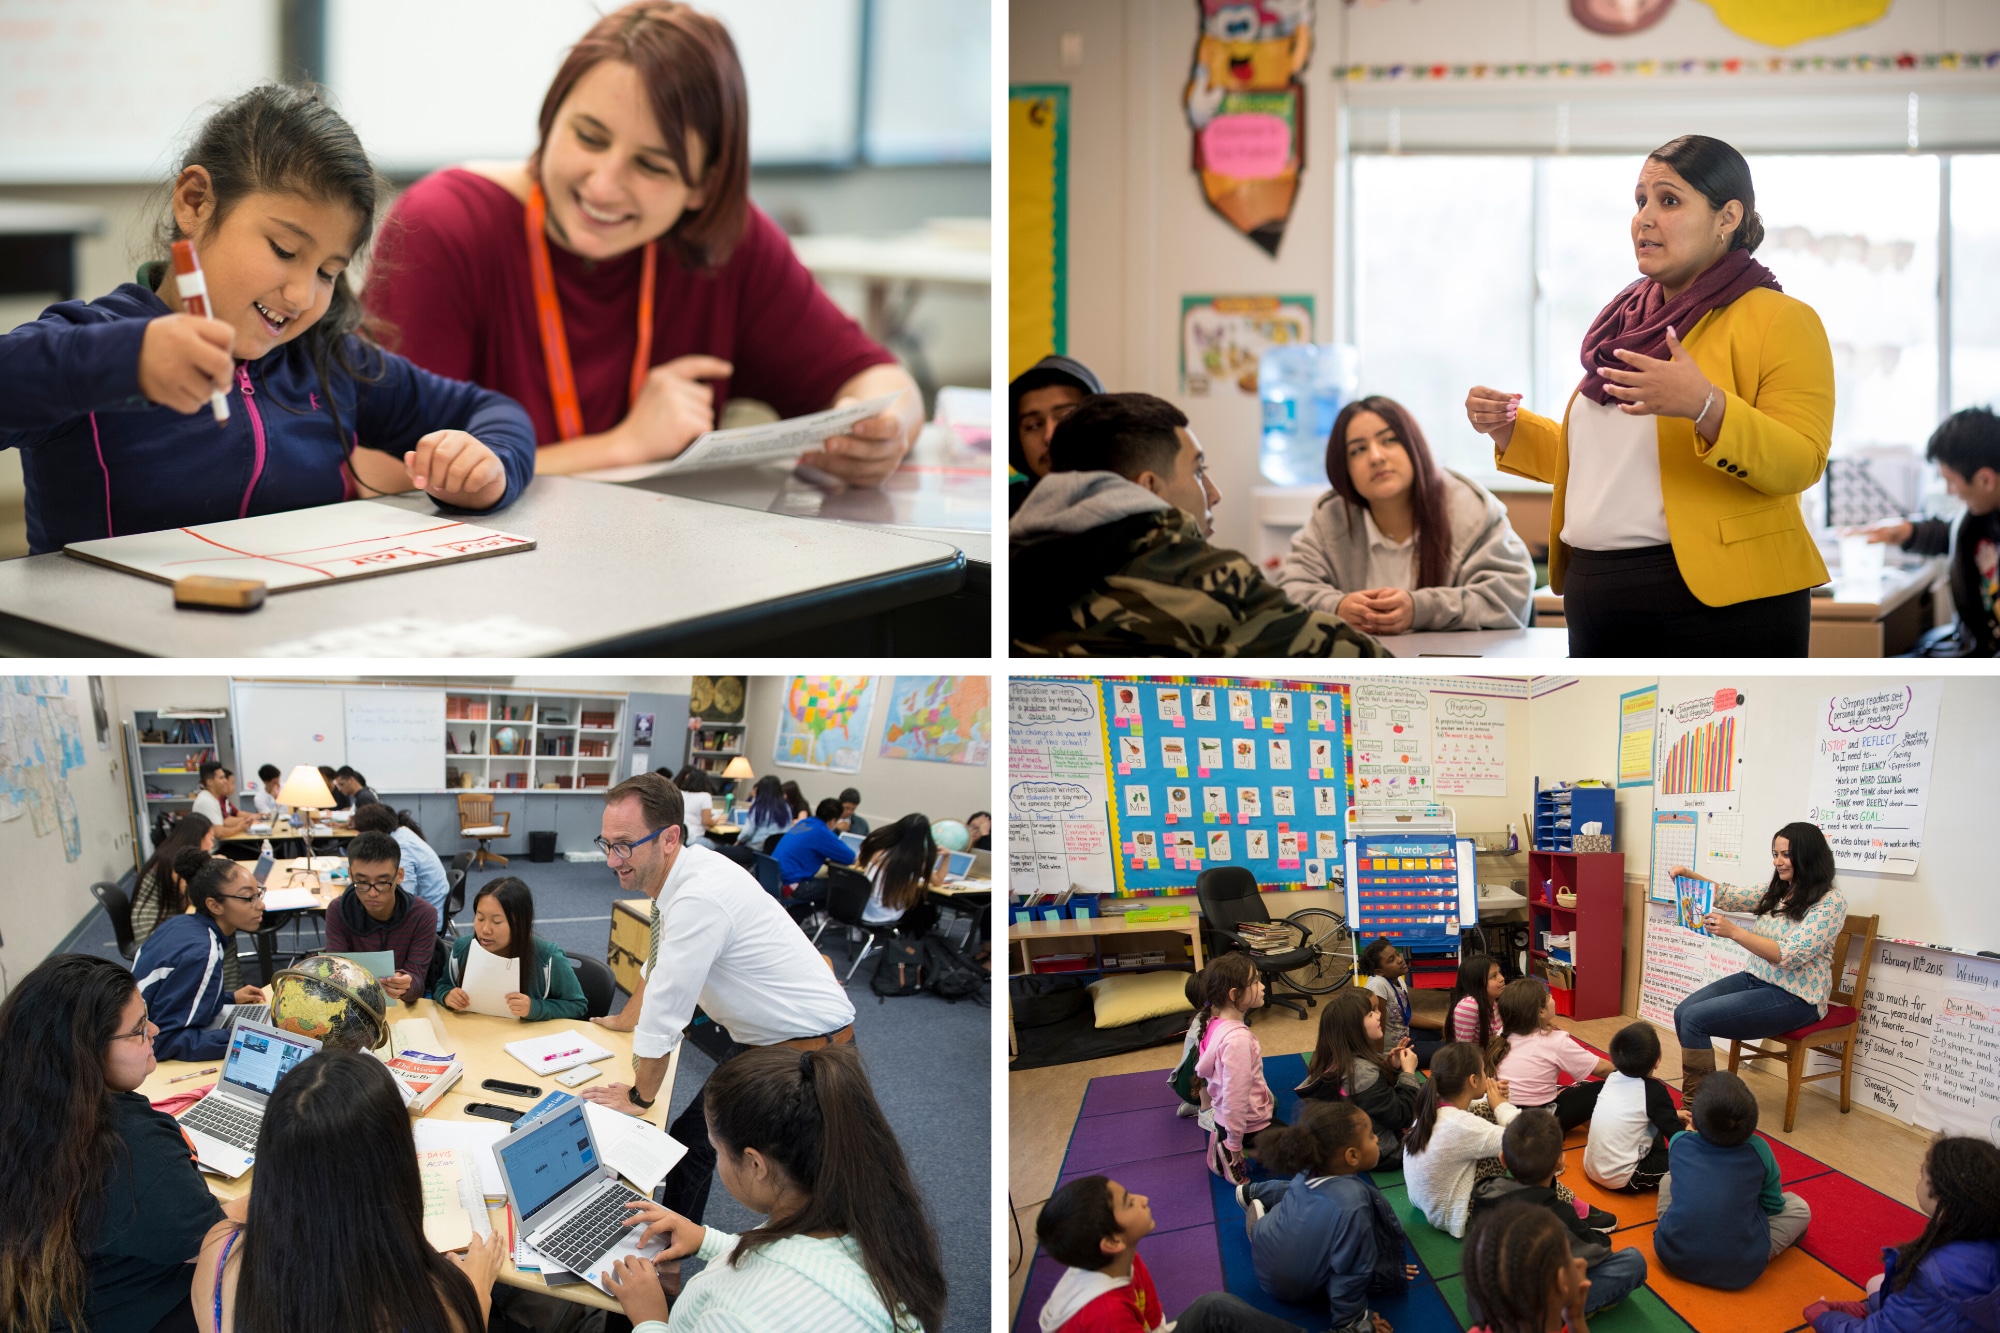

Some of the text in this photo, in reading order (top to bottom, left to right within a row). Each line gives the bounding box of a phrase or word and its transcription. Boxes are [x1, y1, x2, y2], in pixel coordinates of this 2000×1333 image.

[1841, 691, 1903, 710] Strong readers set
[1834, 701, 1903, 723] personal goals to improve
[1848, 714, 1890, 726] their reading
[1905, 730, 1926, 741] Reading
[1828, 734, 1896, 751] STOP and REFLECT
[1901, 738, 1929, 749] Smoothly
[1841, 752, 1846, 761] I
[1848, 750, 1861, 760] need
[1894, 751, 1911, 763] Pacing
[1862, 760, 1886, 772] FLUENCY
[1892, 761, 1920, 770] Expression
[1860, 776, 1875, 785] WORD
[1877, 774, 1901, 784] SOLVING
[1850, 787, 1859, 795] and
[1877, 787, 1892, 795] about
[1894, 786, 1905, 794] book
[1867, 798, 1888, 808] DEEPLY
[1820, 810, 1835, 820] SET
[1843, 810, 1858, 820] focus
[1841, 836, 1851, 845] idea
[1854, 837, 1870, 845] about
[1394, 846, 1422, 854] March
[1835, 849, 1887, 863] reach my goal by
[1881, 949, 1911, 974] February
[1925, 961, 1943, 976] 2015
[1957, 962, 1988, 991] Writing
[1876, 991, 1926, 1011] so much for
[1947, 999, 1962, 1011] Dear
[1870, 1012, 1905, 1032] My favorite
[1890, 1009, 1907, 1022] years
[1908, 1011, 1919, 1022] old
[1920, 1014, 1933, 1025] and
[1857, 1025, 1869, 1036] like
[1934, 1023, 1944, 1033] In
[1970, 1020, 1994, 1034] learned
[1865, 1039, 1873, 1050] of
[1874, 1042, 1894, 1057] school
[1932, 1035, 1946, 1048] 3-D
[1976, 1049, 1991, 1061] and
[1928, 1058, 1935, 1066] to
[1930, 1047, 1994, 1074] reading the book
[396, 1061, 437, 1073] The Words
[401, 1071, 418, 1079] Live
[1924, 1072, 1976, 1094] with long vowel
[1979, 1075, 1994, 1088] also
[1864, 1077, 1892, 1099] Sincerely,
[1921, 1080, 1975, 1107] for tomorrow!
[1873, 1091, 1899, 1112] Miss Joy
[427, 1151, 452, 1159] DAVIS
